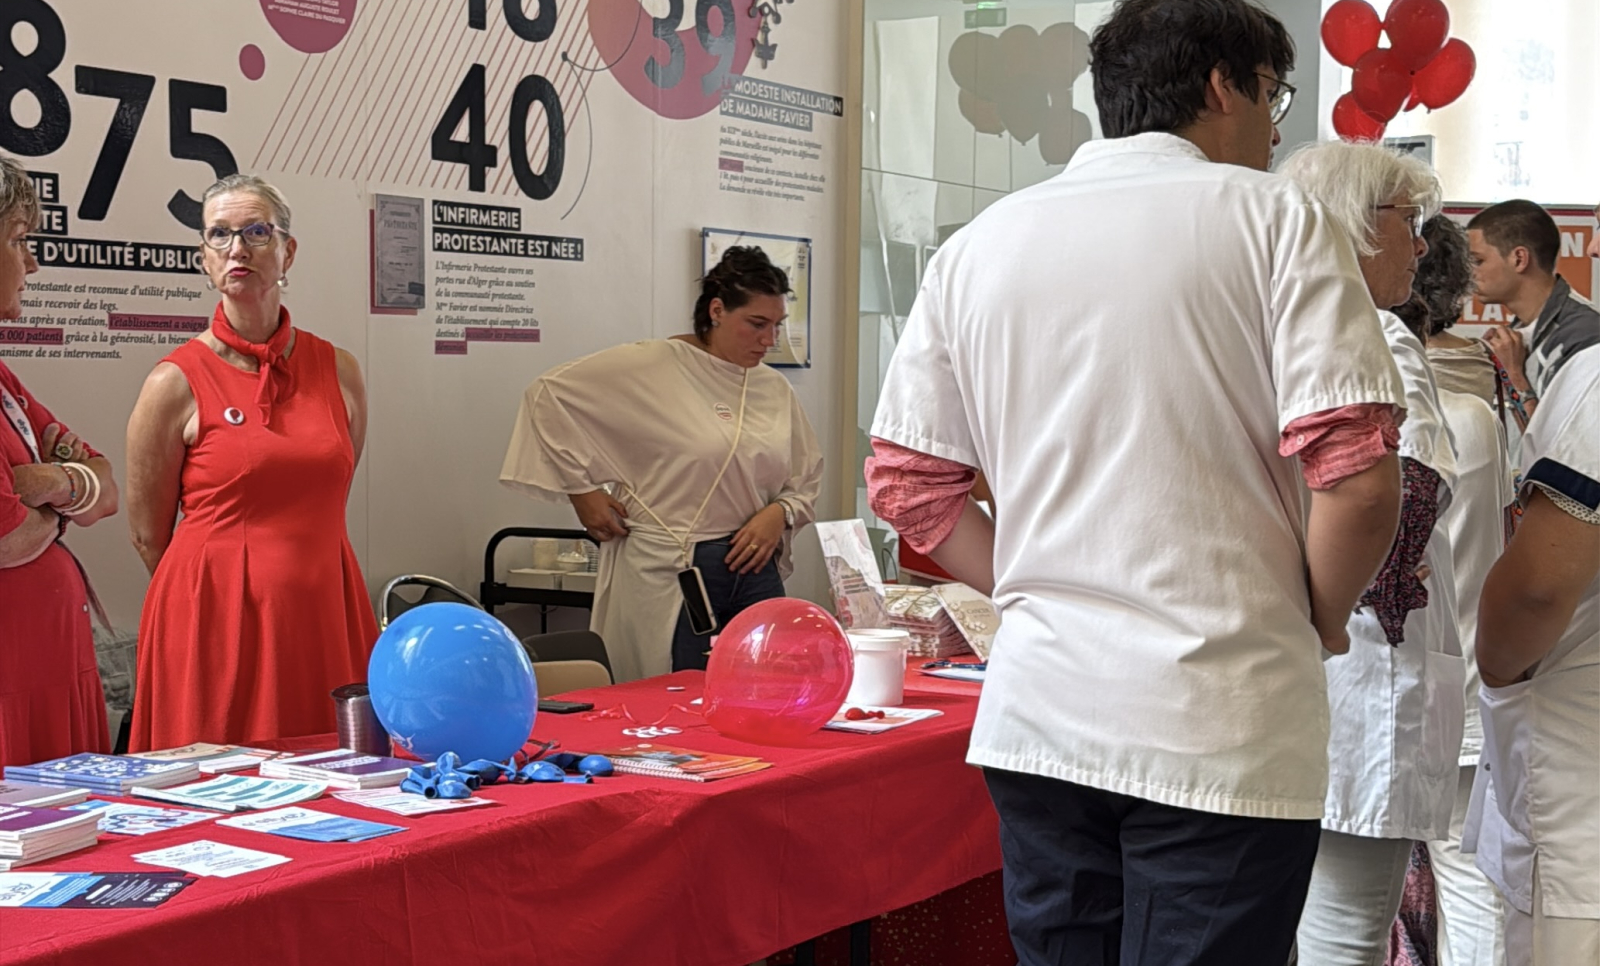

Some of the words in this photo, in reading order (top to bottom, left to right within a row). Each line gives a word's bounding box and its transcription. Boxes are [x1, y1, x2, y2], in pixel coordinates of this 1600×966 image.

[734, 80, 779, 100] MODESTE
[781, 89, 841, 113] INSTALLATION
[721, 99, 734, 113] DE
[736, 102, 779, 121] MADAME
[780, 110, 810, 127] FAVIER
[431, 63, 566, 201] 40
[434, 204, 519, 228] L'INFIRMERIE
[434, 232, 525, 255] PROTESTANTE
[528, 240, 549, 256] EST
[44, 241, 134, 266] D'UTILITÉ
[474, 263, 507, 273] Protestante
[435, 276, 454, 286] portes
[488, 278, 505, 288] grâce
[74, 284, 86, 293] est
[88, 286, 129, 295] reconnue
[130, 285, 165, 296] d'utilité
[165, 287, 202, 301] publique
[435, 288, 443, 297] de
[444, 288, 450, 297] la
[45, 299, 81, 309] recevoir
[83, 299, 98, 310] des
[505, 304, 534, 314] Directrice
[30, 314, 54, 327] après
[68, 315, 107, 328] création,
[435, 315, 443, 324] de
[26, 332, 63, 344] patients
[65, 332, 89, 344] grâce
[91, 331, 97, 342] à
[99, 332, 108, 342] la
[110, 332, 156, 346] générosité,
[158, 334, 166, 344] la
[35, 347, 47, 357] de
[64, 348, 122, 359] intervenants.
